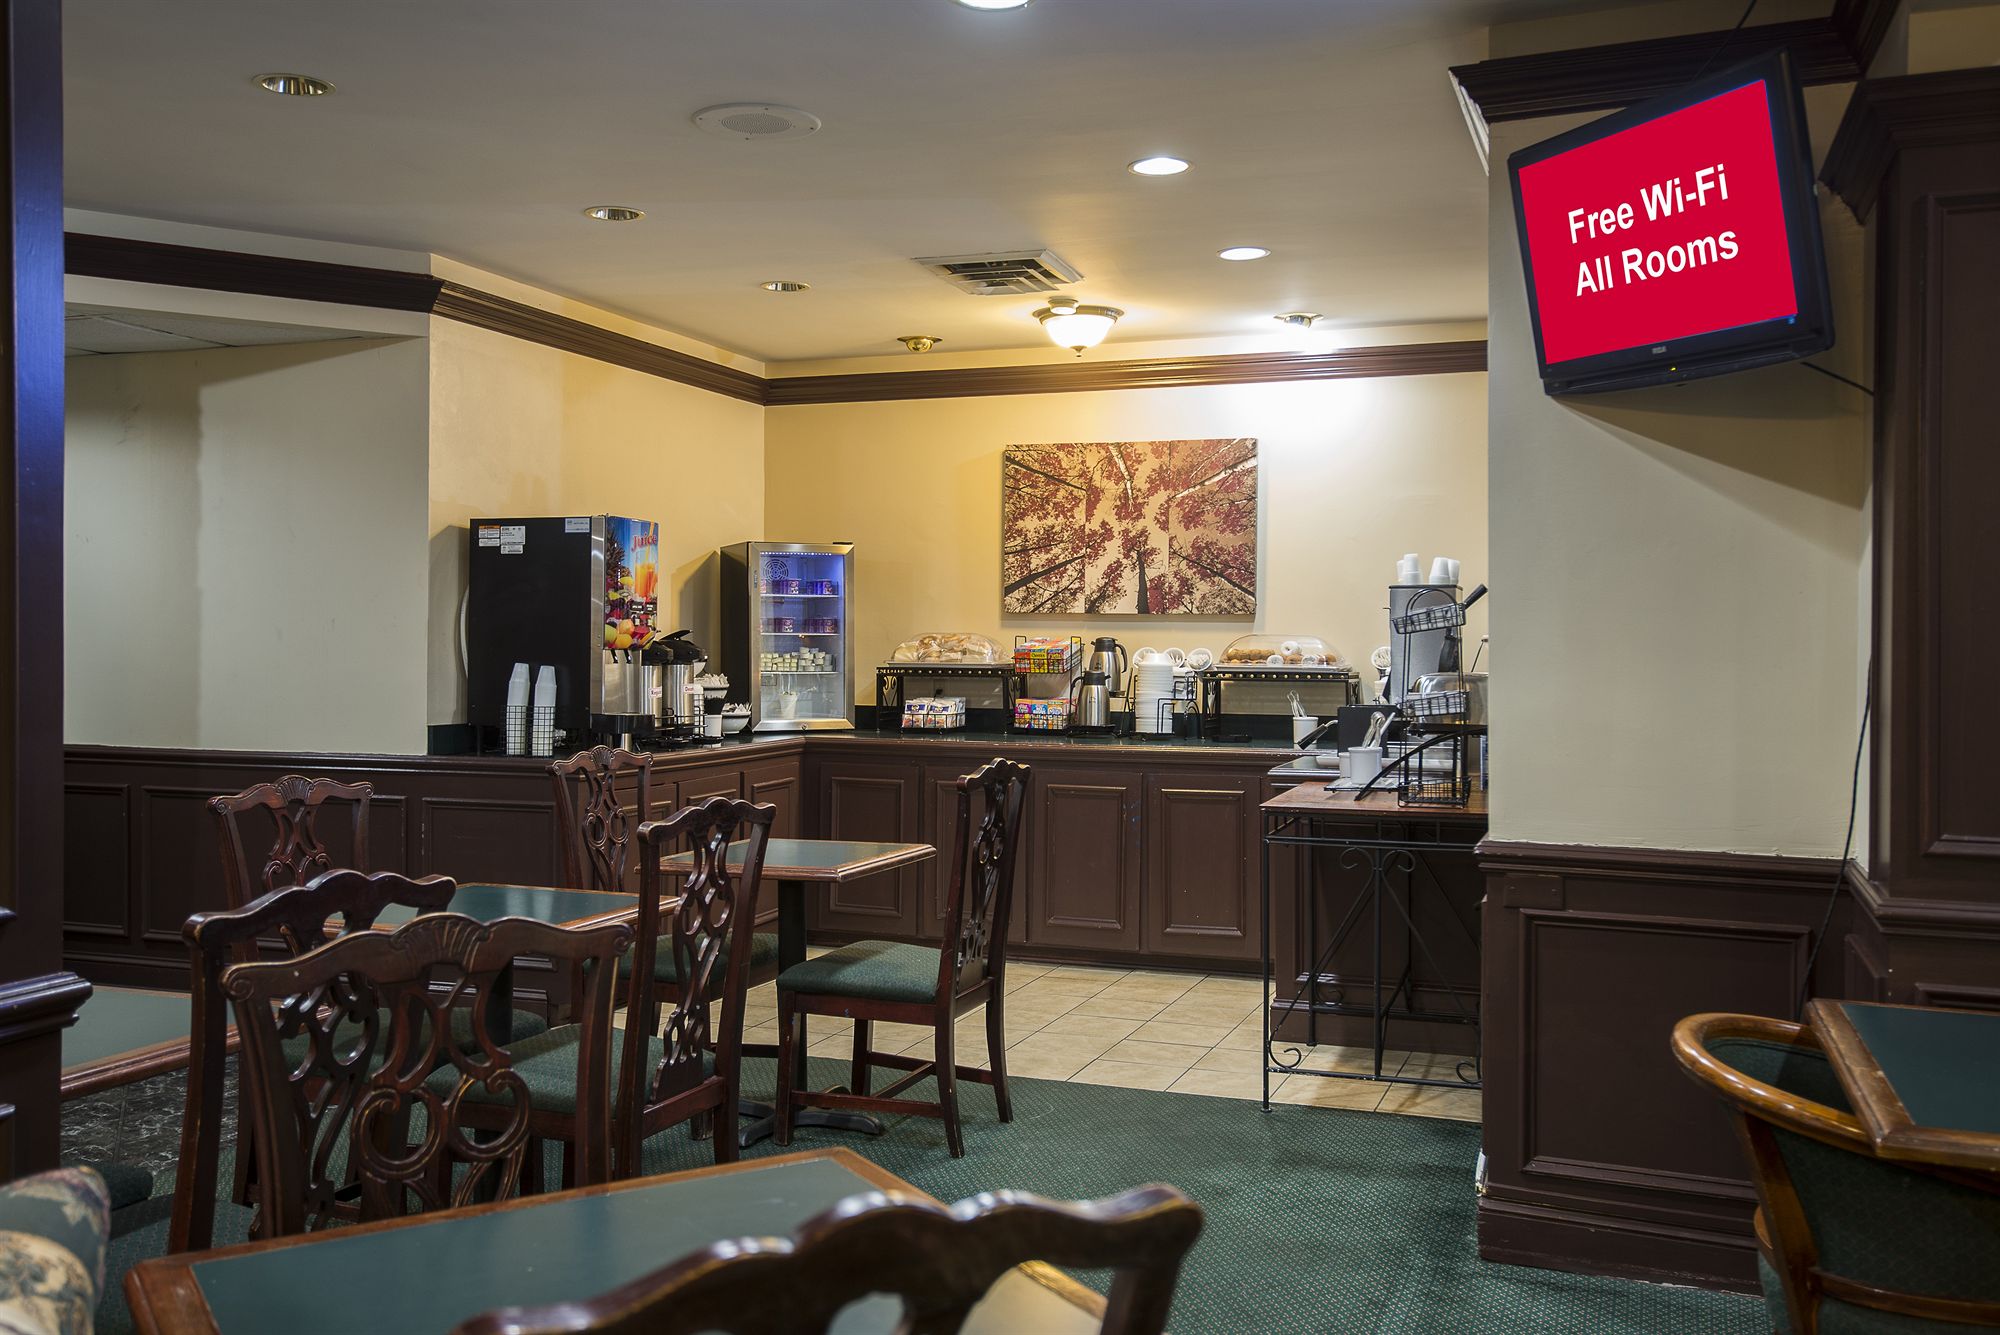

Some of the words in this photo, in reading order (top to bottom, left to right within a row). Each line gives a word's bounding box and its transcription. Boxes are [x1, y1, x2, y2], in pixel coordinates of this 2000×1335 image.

[1567, 202, 1634, 244] Free
[1640, 163, 1729, 222] Wi-Fi
[1576, 255, 1614, 297] All
[1621, 230, 1739, 285] Rooms
[631, 532, 657, 552] Juice
